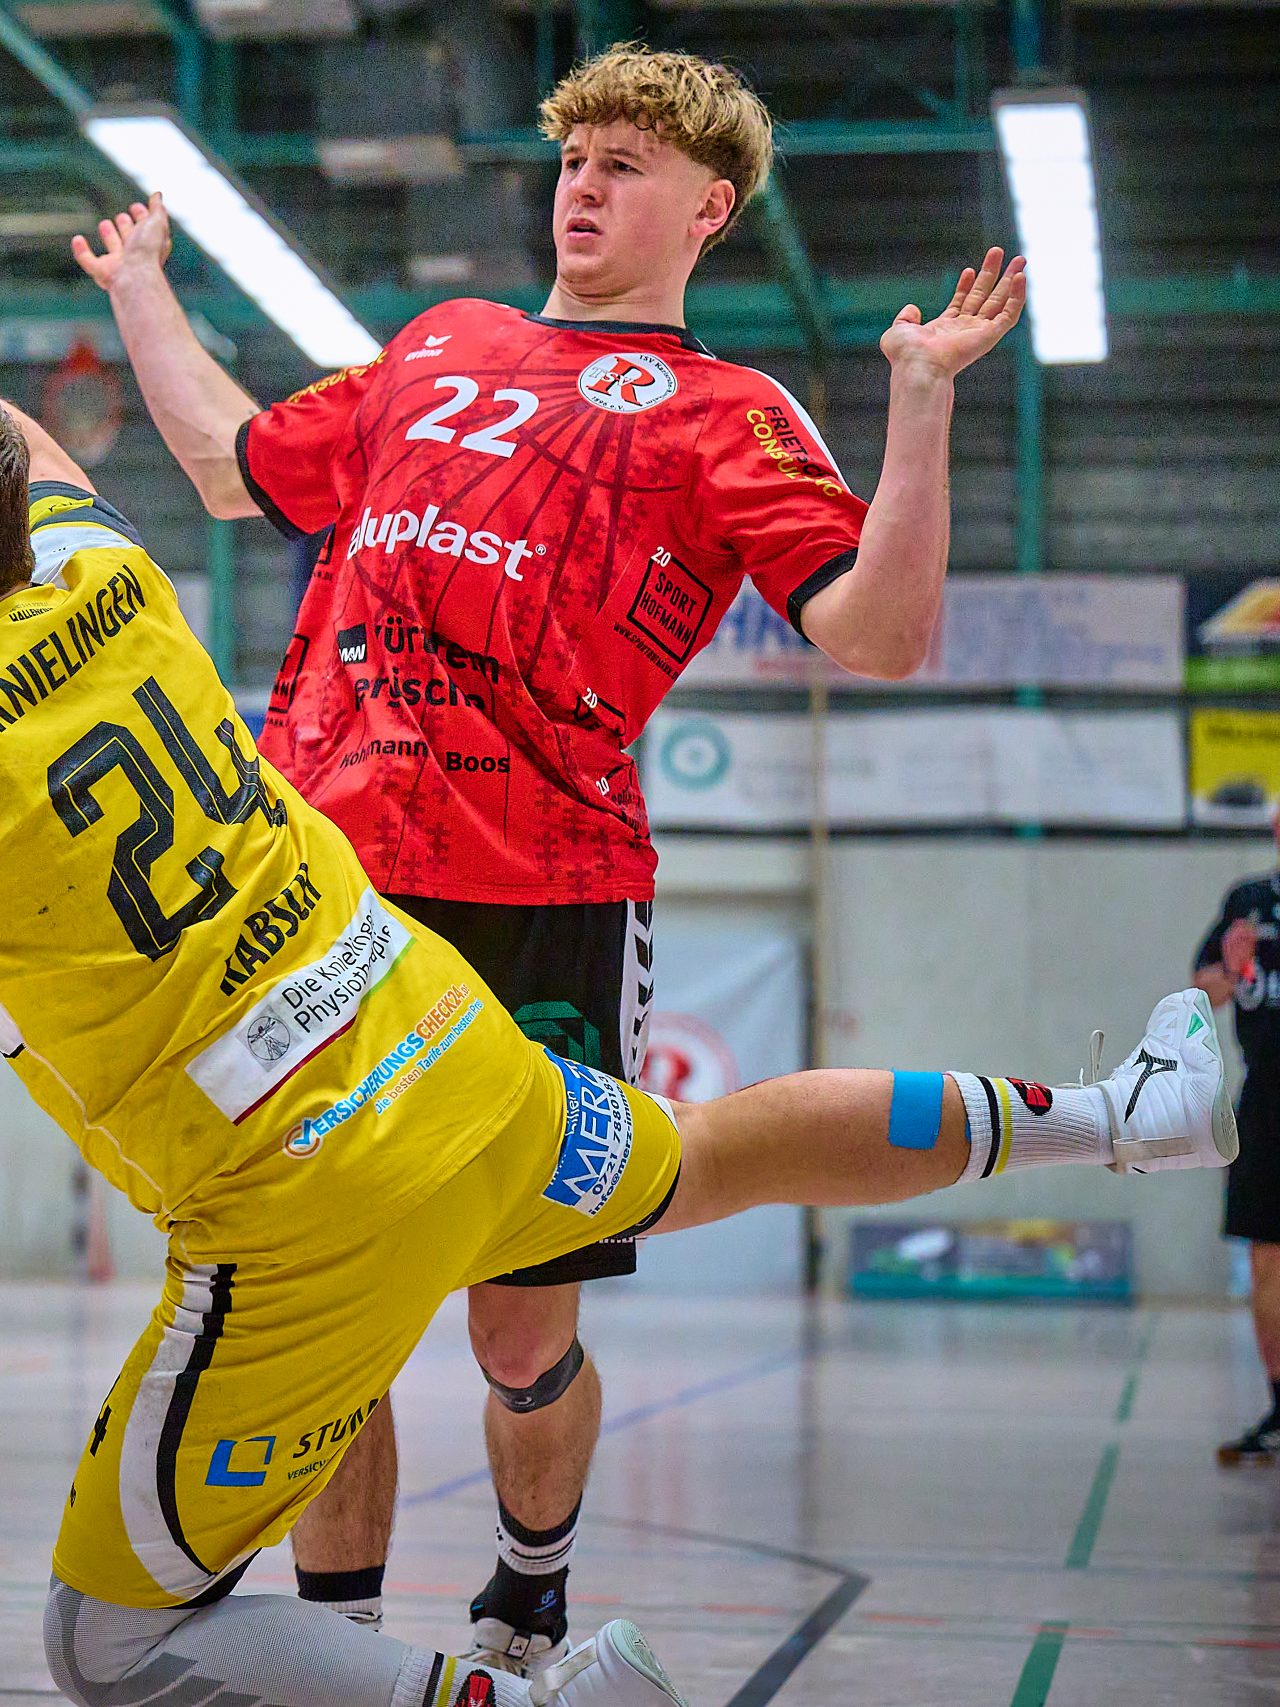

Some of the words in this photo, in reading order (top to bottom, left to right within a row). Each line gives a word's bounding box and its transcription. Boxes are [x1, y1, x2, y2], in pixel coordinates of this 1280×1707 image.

[405, 375, 539, 459] 22
[639, 591, 693, 645] HOFMANN
[655, 572, 697, 617] SPORT
[446, 751, 510, 773] Boos
[47, 675, 288, 962] 24
[281, 974, 322, 1009] Die
[389, 1068, 422, 1100] besten
[417, 1047, 442, 1072] Tarife
[439, 1031, 456, 1052] zum
[452, 1011, 476, 1036] besten
[592, 1152, 618, 1196] 0721
